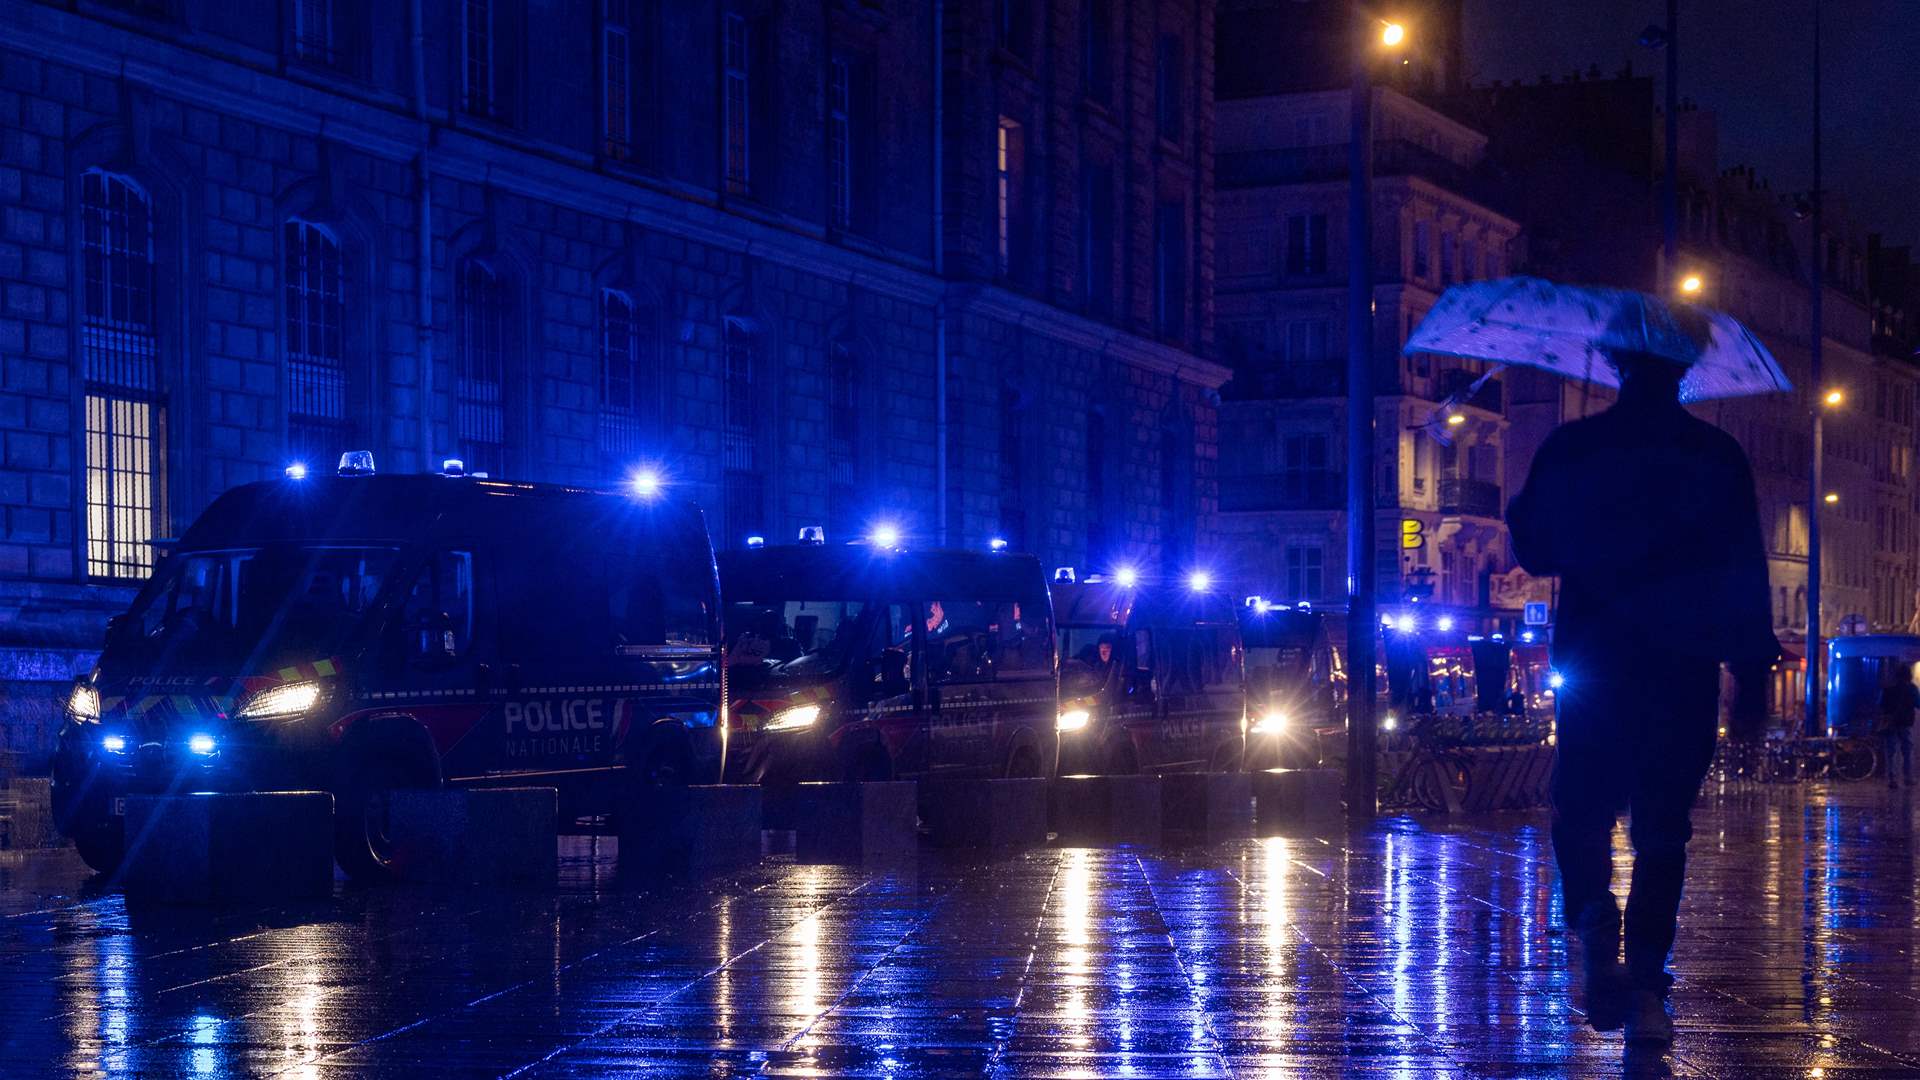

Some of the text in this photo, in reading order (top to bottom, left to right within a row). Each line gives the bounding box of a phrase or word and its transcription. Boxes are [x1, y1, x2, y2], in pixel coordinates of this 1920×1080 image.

[129, 675, 196, 686] POLICE
[504, 698, 605, 734] POLICE
[505, 735, 602, 757] NATIONALE
